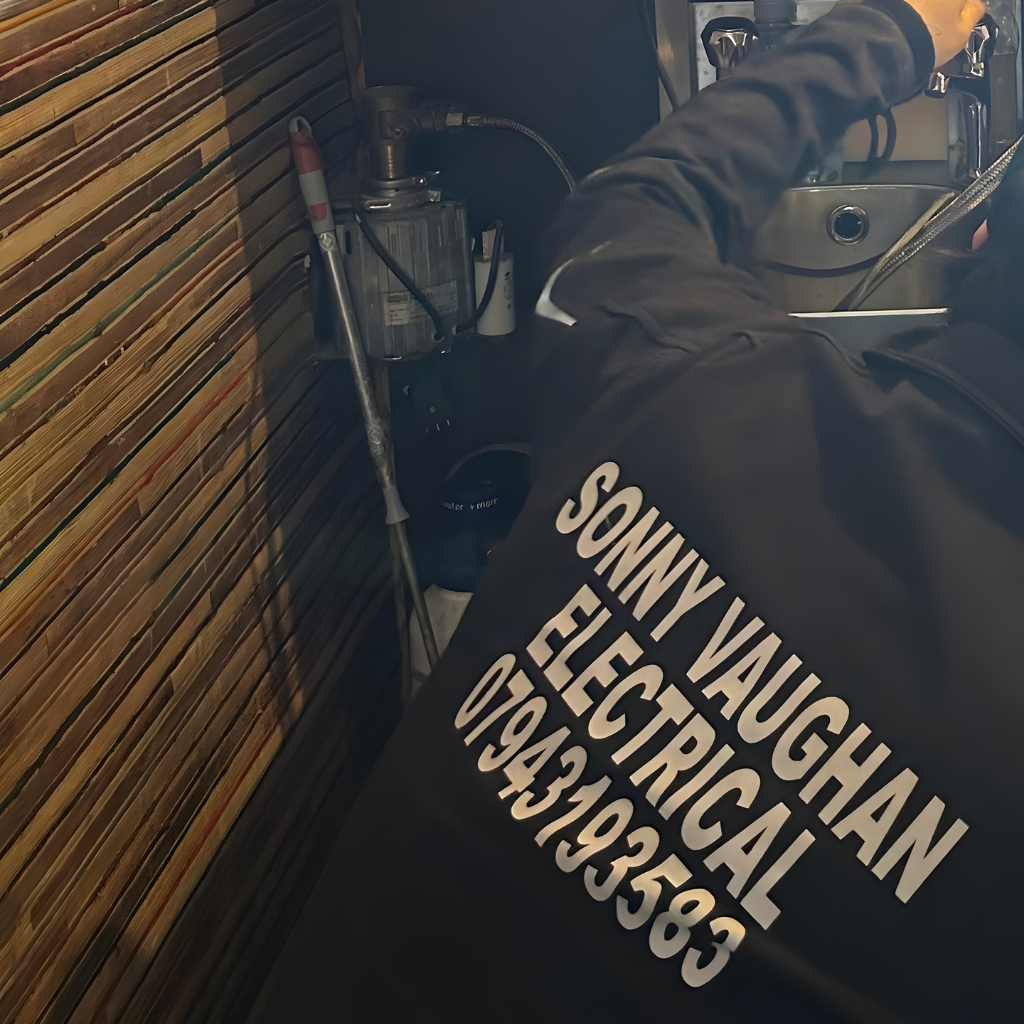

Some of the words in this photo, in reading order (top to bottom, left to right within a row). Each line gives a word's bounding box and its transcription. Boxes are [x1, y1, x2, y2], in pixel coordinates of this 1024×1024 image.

[454, 653, 746, 988] 07943193583
[525, 584, 816, 931] ELECTRICAL
[555, 461, 726, 642] SONNY
[686, 596, 970, 904] VAUGHAN
